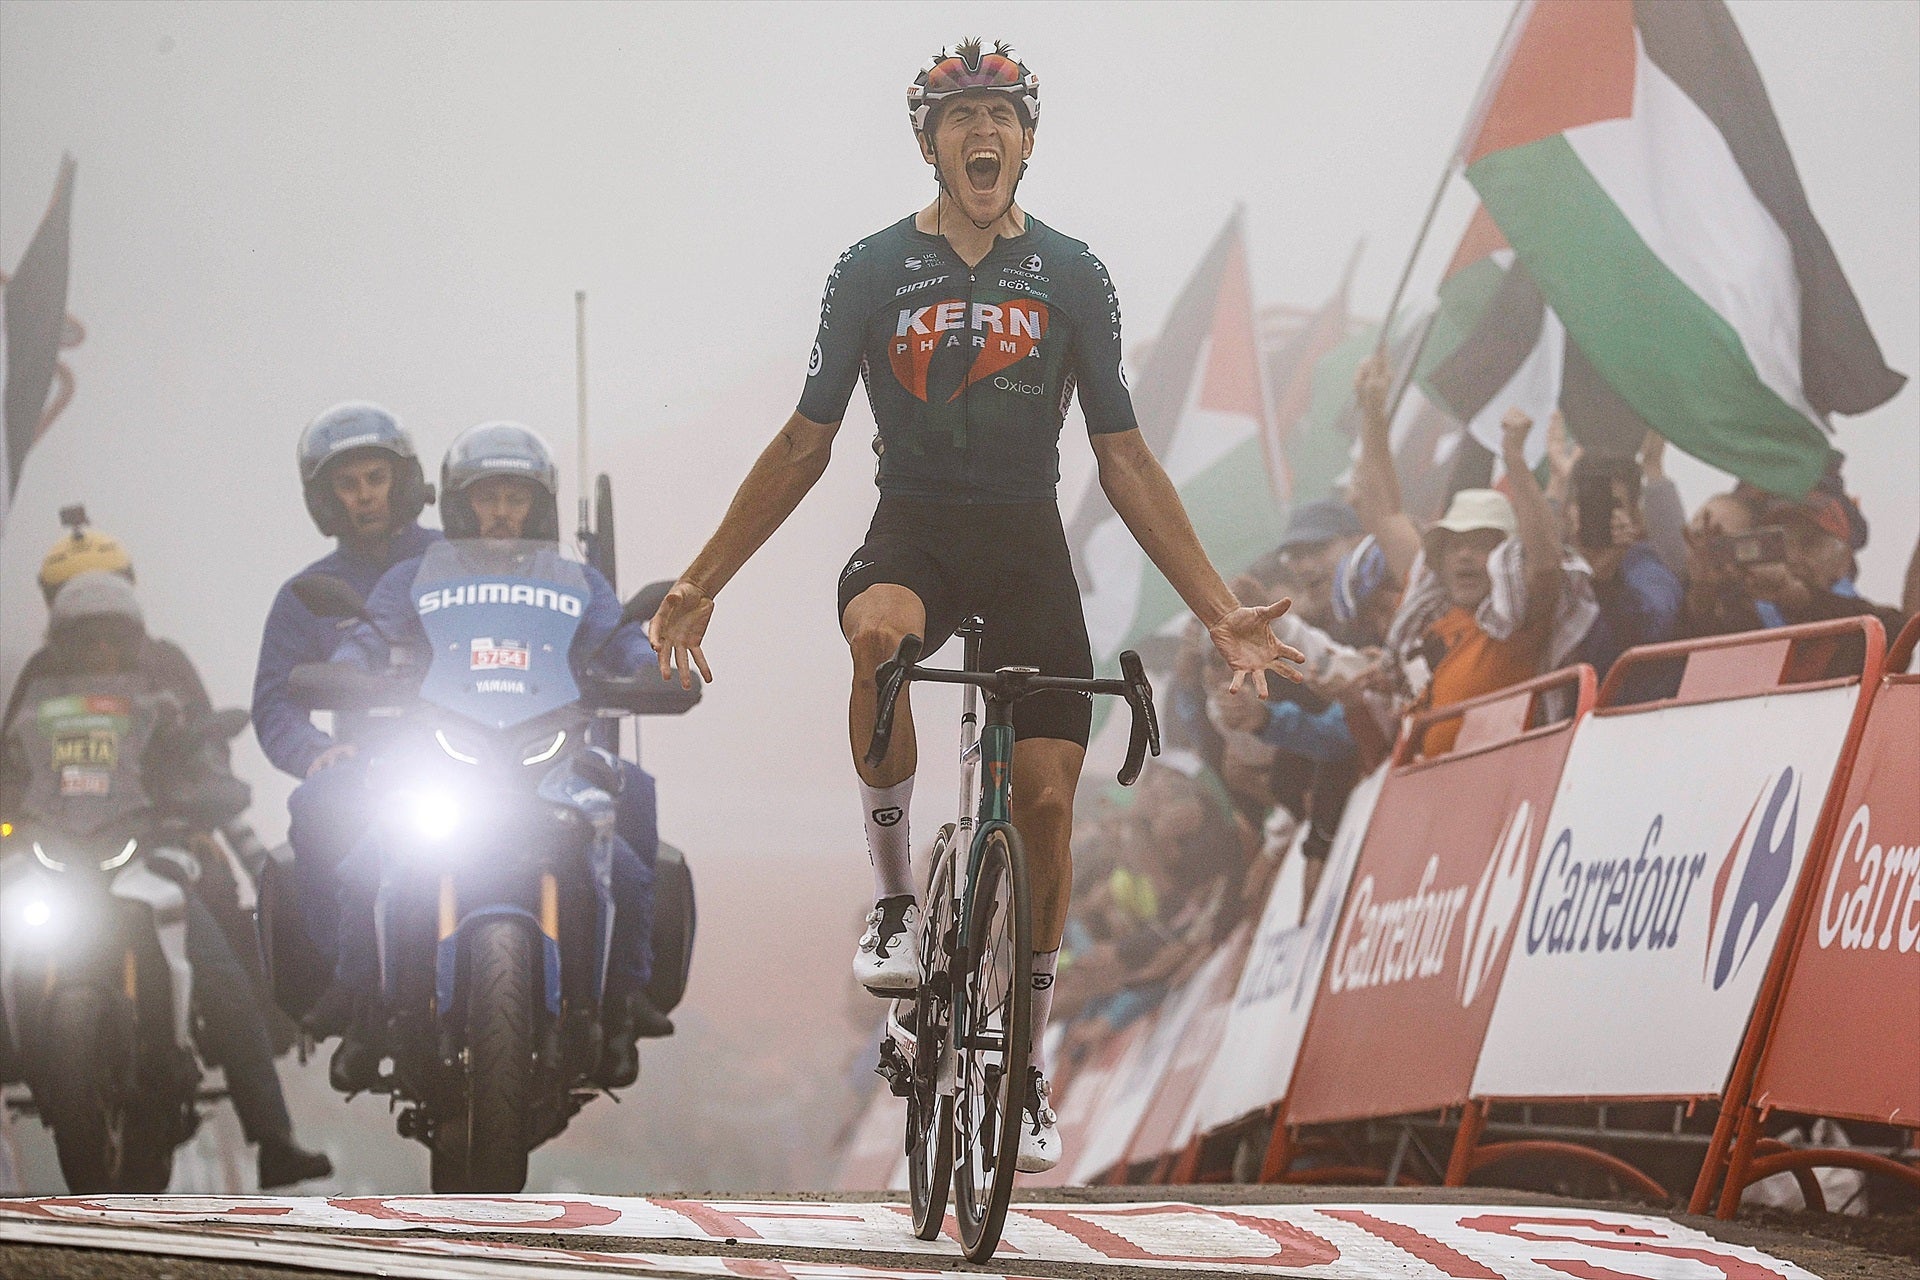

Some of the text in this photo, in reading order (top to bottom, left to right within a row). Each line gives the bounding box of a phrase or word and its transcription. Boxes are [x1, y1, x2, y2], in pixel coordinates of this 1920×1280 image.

[895, 275, 949, 297] GIANT
[999, 279, 1023, 291] BCD
[896, 302, 1041, 340] KERN
[896, 335, 1040, 359] PHARMA
[993, 376, 1045, 396] Oxicol
[418, 583, 582, 618] SHIMANO
[476, 680, 525, 694] YAMAHA
[1526, 814, 1706, 956] Carrefour
[1817, 803, 1920, 954] Carre
[1330, 854, 1467, 994] Carrefour
